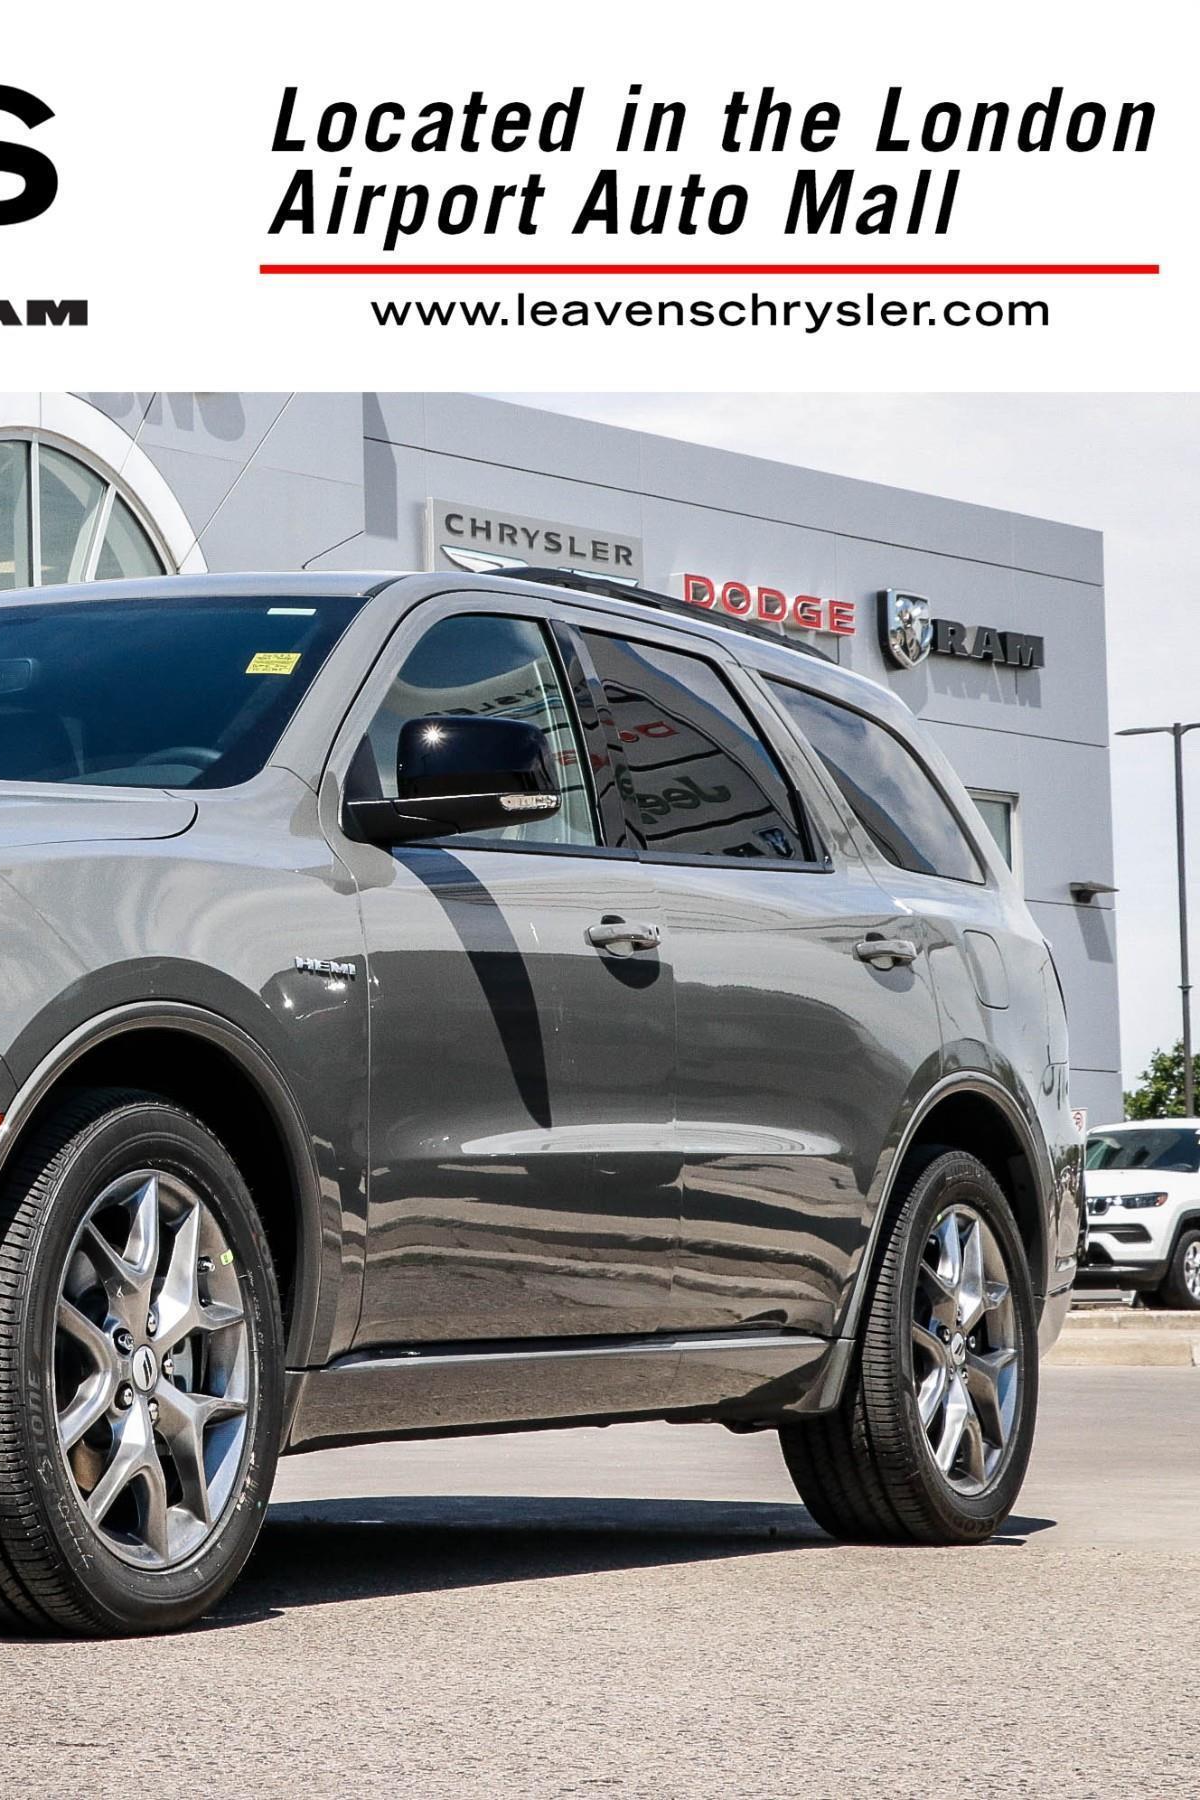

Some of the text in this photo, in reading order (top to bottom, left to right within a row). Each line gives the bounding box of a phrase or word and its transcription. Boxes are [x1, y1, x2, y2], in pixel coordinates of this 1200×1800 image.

[444, 512, 634, 567] CHRYSLER
[682, 572, 858, 636] DODGE
[931, 618, 1045, 670] RAM
[294, 956, 357, 976] HEMI
